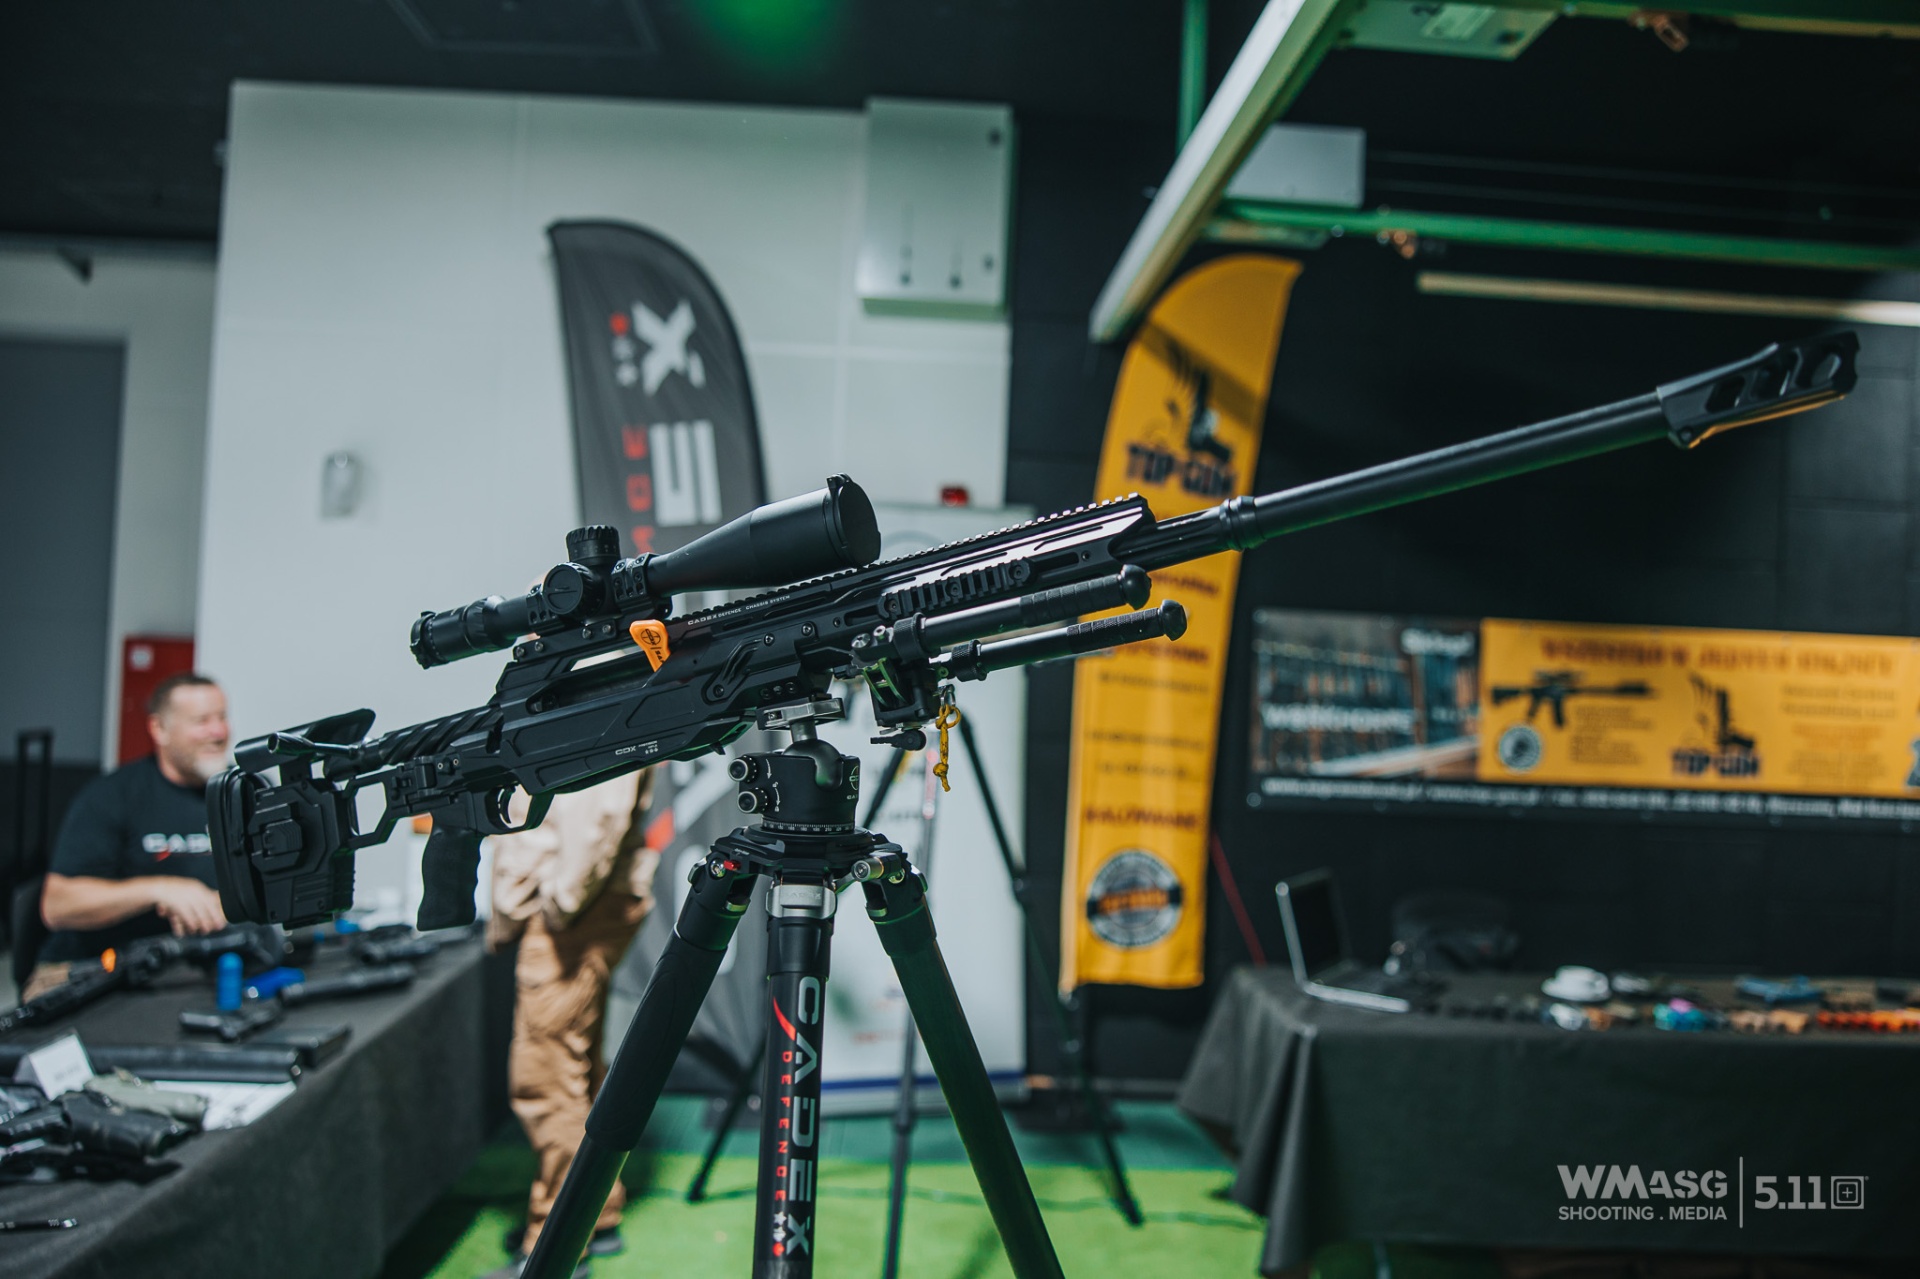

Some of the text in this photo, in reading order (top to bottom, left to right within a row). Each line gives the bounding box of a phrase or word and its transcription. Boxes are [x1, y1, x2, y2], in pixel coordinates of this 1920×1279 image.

[687, 595, 791, 626] CADEX DEFENCE CHASSIS SYSTEM
[614, 745, 637, 756] CDX
[775, 1051, 793, 1201] DEFENCE
[786, 976, 821, 1256] CADEX
